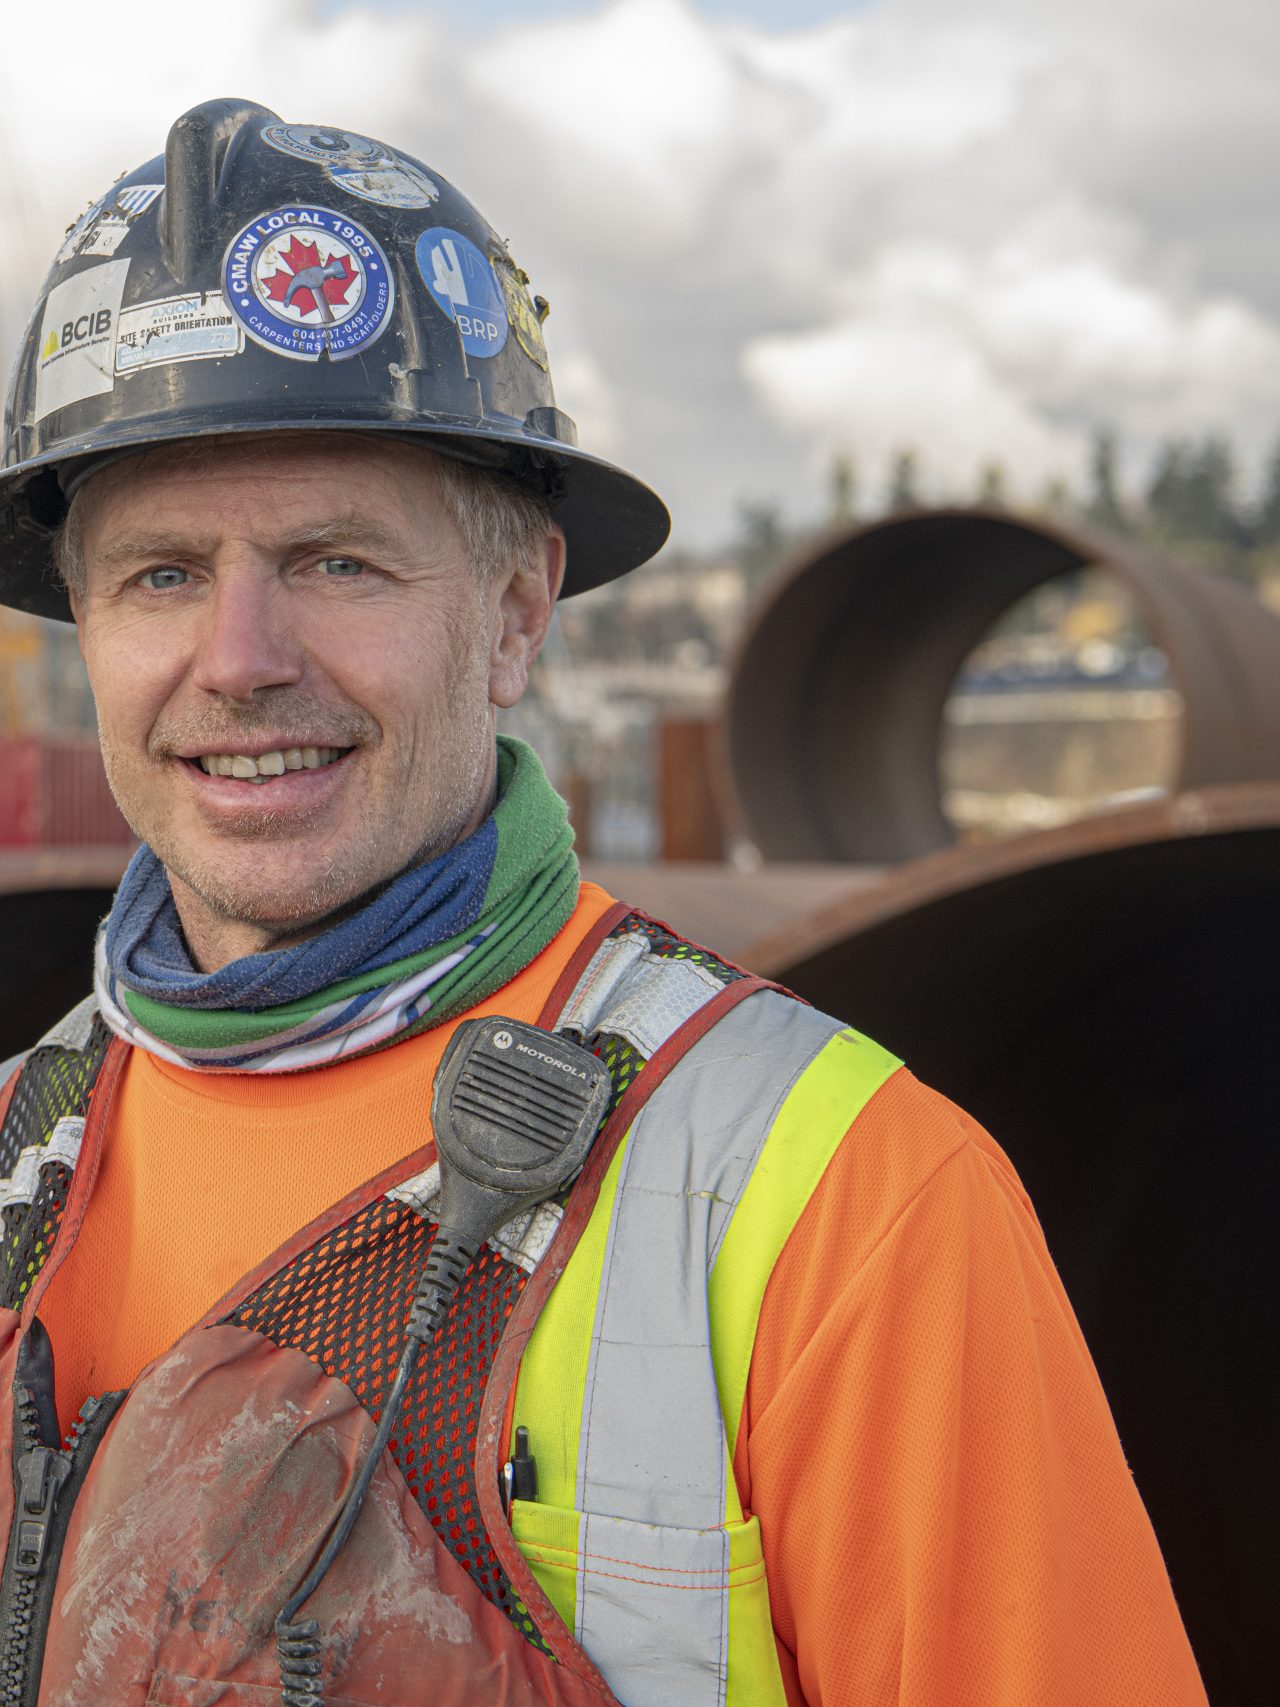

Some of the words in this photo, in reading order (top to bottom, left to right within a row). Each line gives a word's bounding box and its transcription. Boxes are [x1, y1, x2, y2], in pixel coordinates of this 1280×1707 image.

[232, 234, 259, 293] CMAW
[255, 212, 325, 236] LOCAL
[332, 220, 374, 258] 1995
[152, 301, 198, 318] AXIOM
[154, 313, 194, 324] BUILDERS
[249, 316, 320, 351] CARPENTERS
[348, 281, 387, 345] SCAFFOLDERS
[61, 309, 111, 347] BCIB
[120, 332, 137, 344] SITE
[175, 316, 233, 332] ORIENTATION
[457, 314, 498, 342] BRP
[516, 1043, 587, 1080] MOTOROLA
